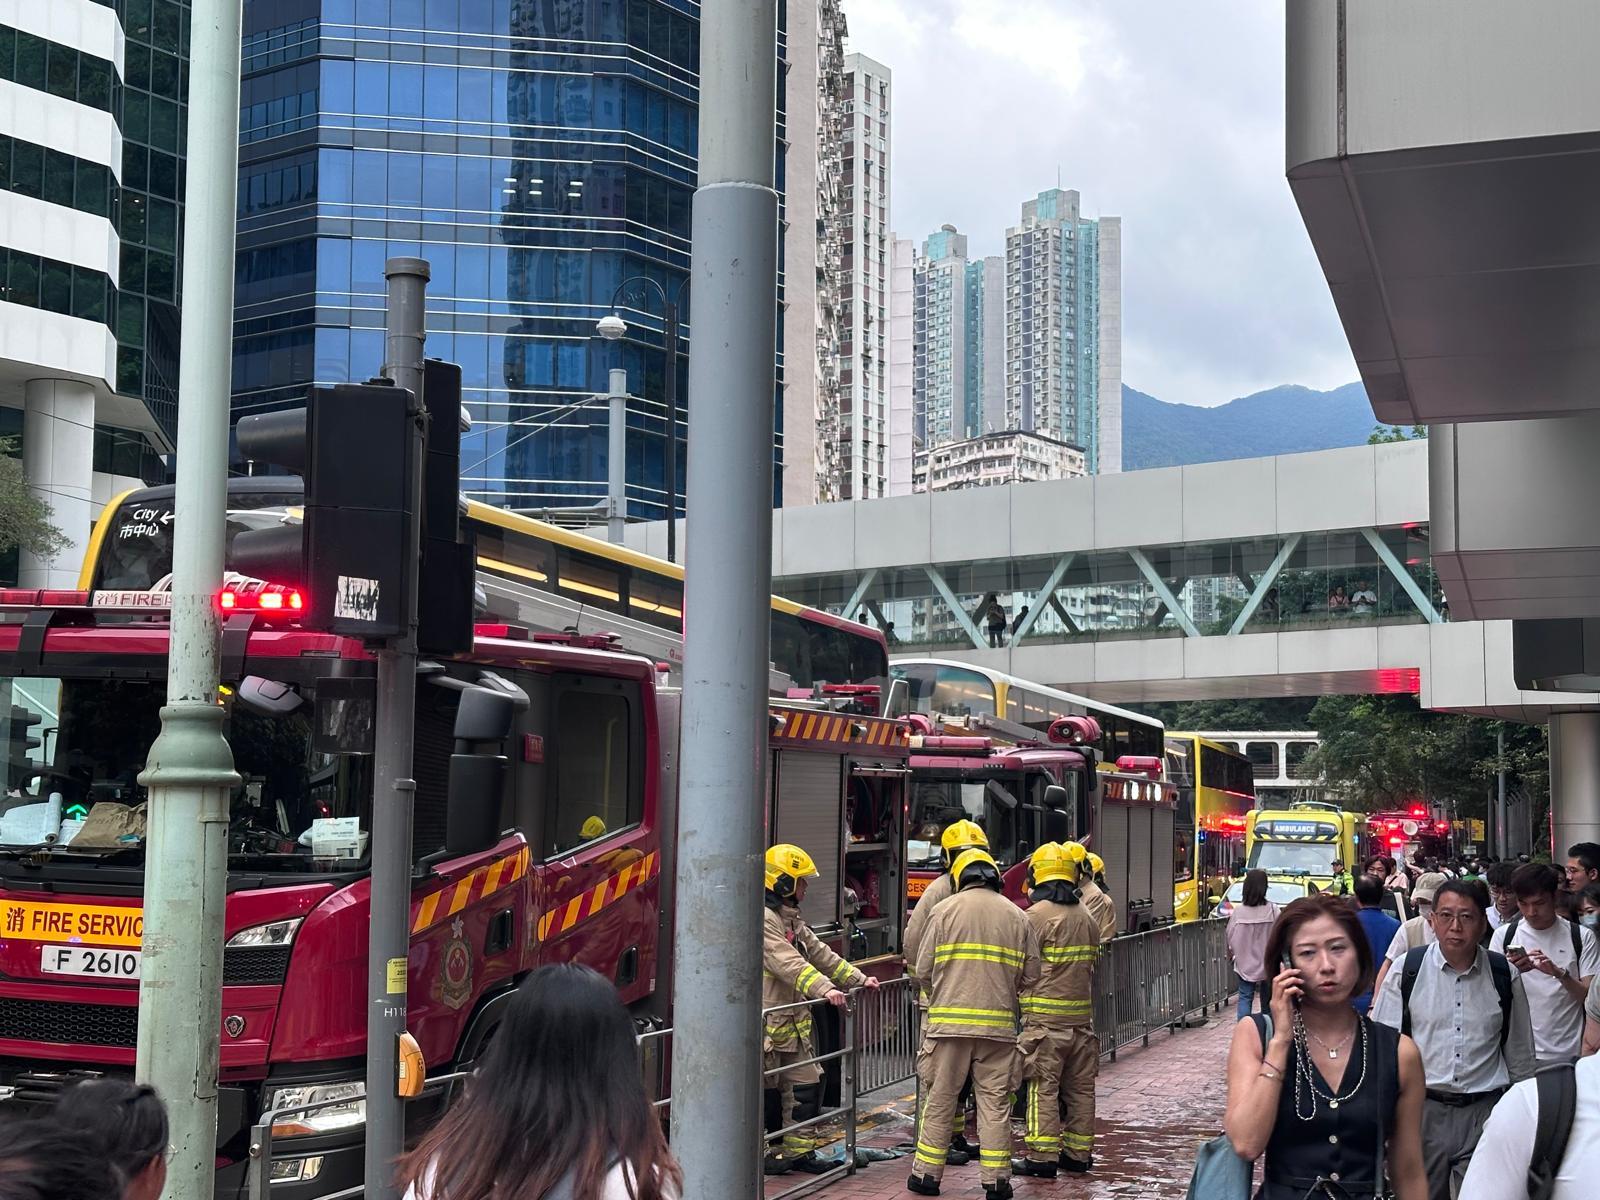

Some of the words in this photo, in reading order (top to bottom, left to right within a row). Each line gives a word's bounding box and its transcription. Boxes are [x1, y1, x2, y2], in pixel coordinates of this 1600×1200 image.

[133, 509, 159, 522] City
[120, 522, 159, 539] 市中心
[120, 593, 163, 606] FIRE
[1274, 825, 1316, 833] AMBULANCE
[6, 907, 26, 933] 消
[32, 910, 74, 934] FIRE
[77, 912, 144, 938] SERVIC
[56, 949, 73, 970] F
[82, 951, 137, 975] 2610
